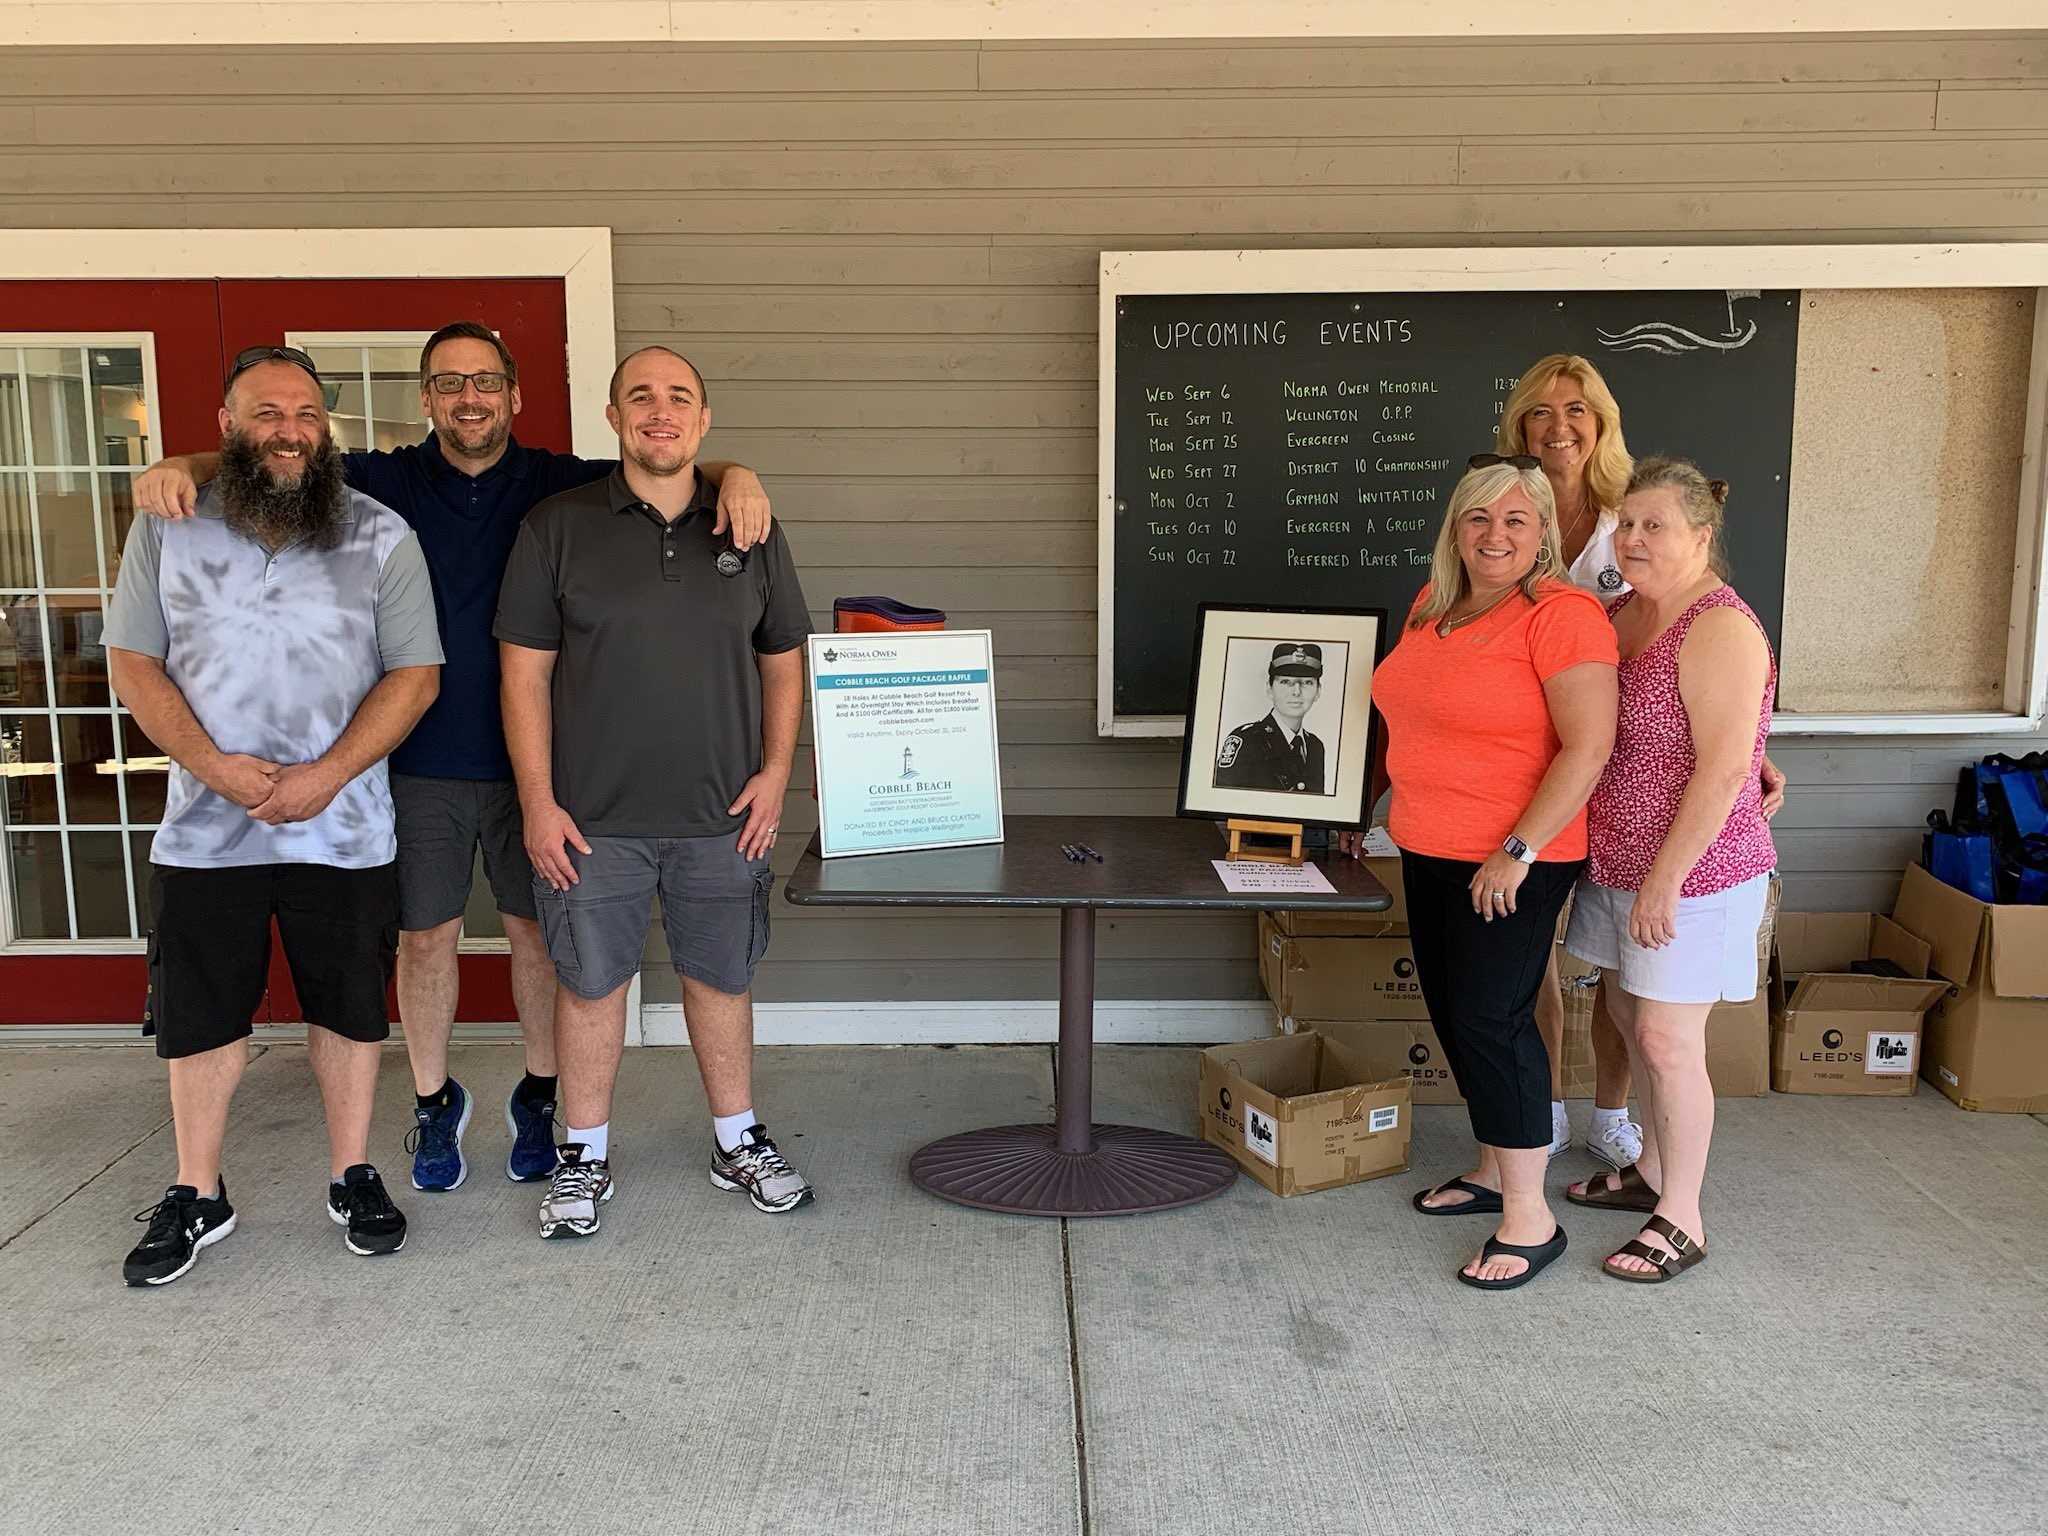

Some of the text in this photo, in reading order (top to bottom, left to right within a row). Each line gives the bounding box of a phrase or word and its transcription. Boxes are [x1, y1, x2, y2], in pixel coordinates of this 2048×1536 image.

[1153, 319, 1412, 350] UPCOMING EVENTS
[1146, 384, 1231, 402] WED SEPT 6
[1284, 380, 1438, 398] NORMA OWEN MEMORIAL
[1185, 410, 1211, 426] SEPT
[1221, 411, 1234, 425] 12
[1285, 405, 1412, 422] WELLINGTON O.P.P.
[1149, 434, 1238, 452] MON SEPT 25
[1287, 431, 1416, 448] EVERGREEN CLOSING
[1149, 464, 1237, 479] WED SEPT 27
[1288, 458, 1449, 476] DISTRICT 10 CHAMPIONSHIP
[1150, 492, 1235, 508] MON OCT 2
[1286, 487, 1436, 506] GRYPHON INVITATION
[1147, 519, 1237, 536] TUES OCT 10
[1287, 517, 1426, 534] EVERGREEN A GROUP
[1148, 546, 1236, 566] SUN OCT 22
[1287, 548, 1349, 567] PREFERRED
[1360, 548, 1398, 567] PLAYER
[835, 673, 971, 686] COBBLE BEACH GOLF PACKAGE RAFFLE
[869, 781, 952, 794] COBBLE BEACH
[844, 821, 877, 830] DONATED
[889, 819, 909, 827] CINDY
[928, 815, 949, 823] BRUCE
[951, 813, 981, 822] CLAYTON
[1373, 982, 1418, 992] LEED
[1800, 1052, 1862, 1062] LEED'S
[1208, 1103, 1245, 1134] LEED'S
